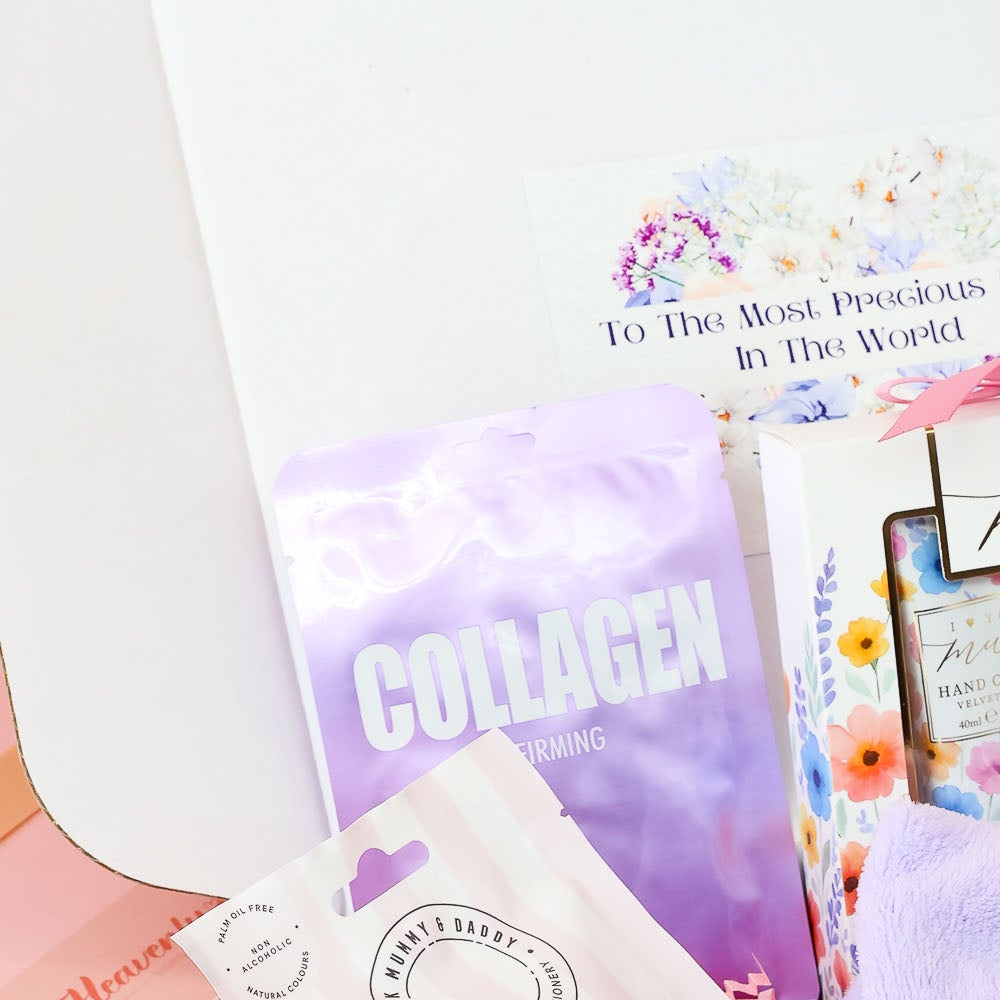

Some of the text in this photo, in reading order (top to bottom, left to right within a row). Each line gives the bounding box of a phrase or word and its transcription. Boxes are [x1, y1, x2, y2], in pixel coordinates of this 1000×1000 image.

[599, 320, 645, 346] To
[657, 311, 725, 338] The
[739, 298, 822, 329] Most
[832, 279, 986, 316] Precious
[736, 316, 966, 371] In The World
[352, 578, 728, 752] COLLAGEN
[937, 678, 986, 699] HAND
[957, 693, 1000, 710] VELVET
[958, 715, 982, 730] 40ml
[217, 903, 275, 944] PALM OIL FREE
[241, 937, 293, 974] ALCOHOLIC
[250, 939, 271, 956] NON
[384, 921, 430, 981] MUMMY
[435, 916, 445, 932] &
[454, 917, 518, 949] DADDY
[246, 950, 310, 1000] NATURAL COLOURS
